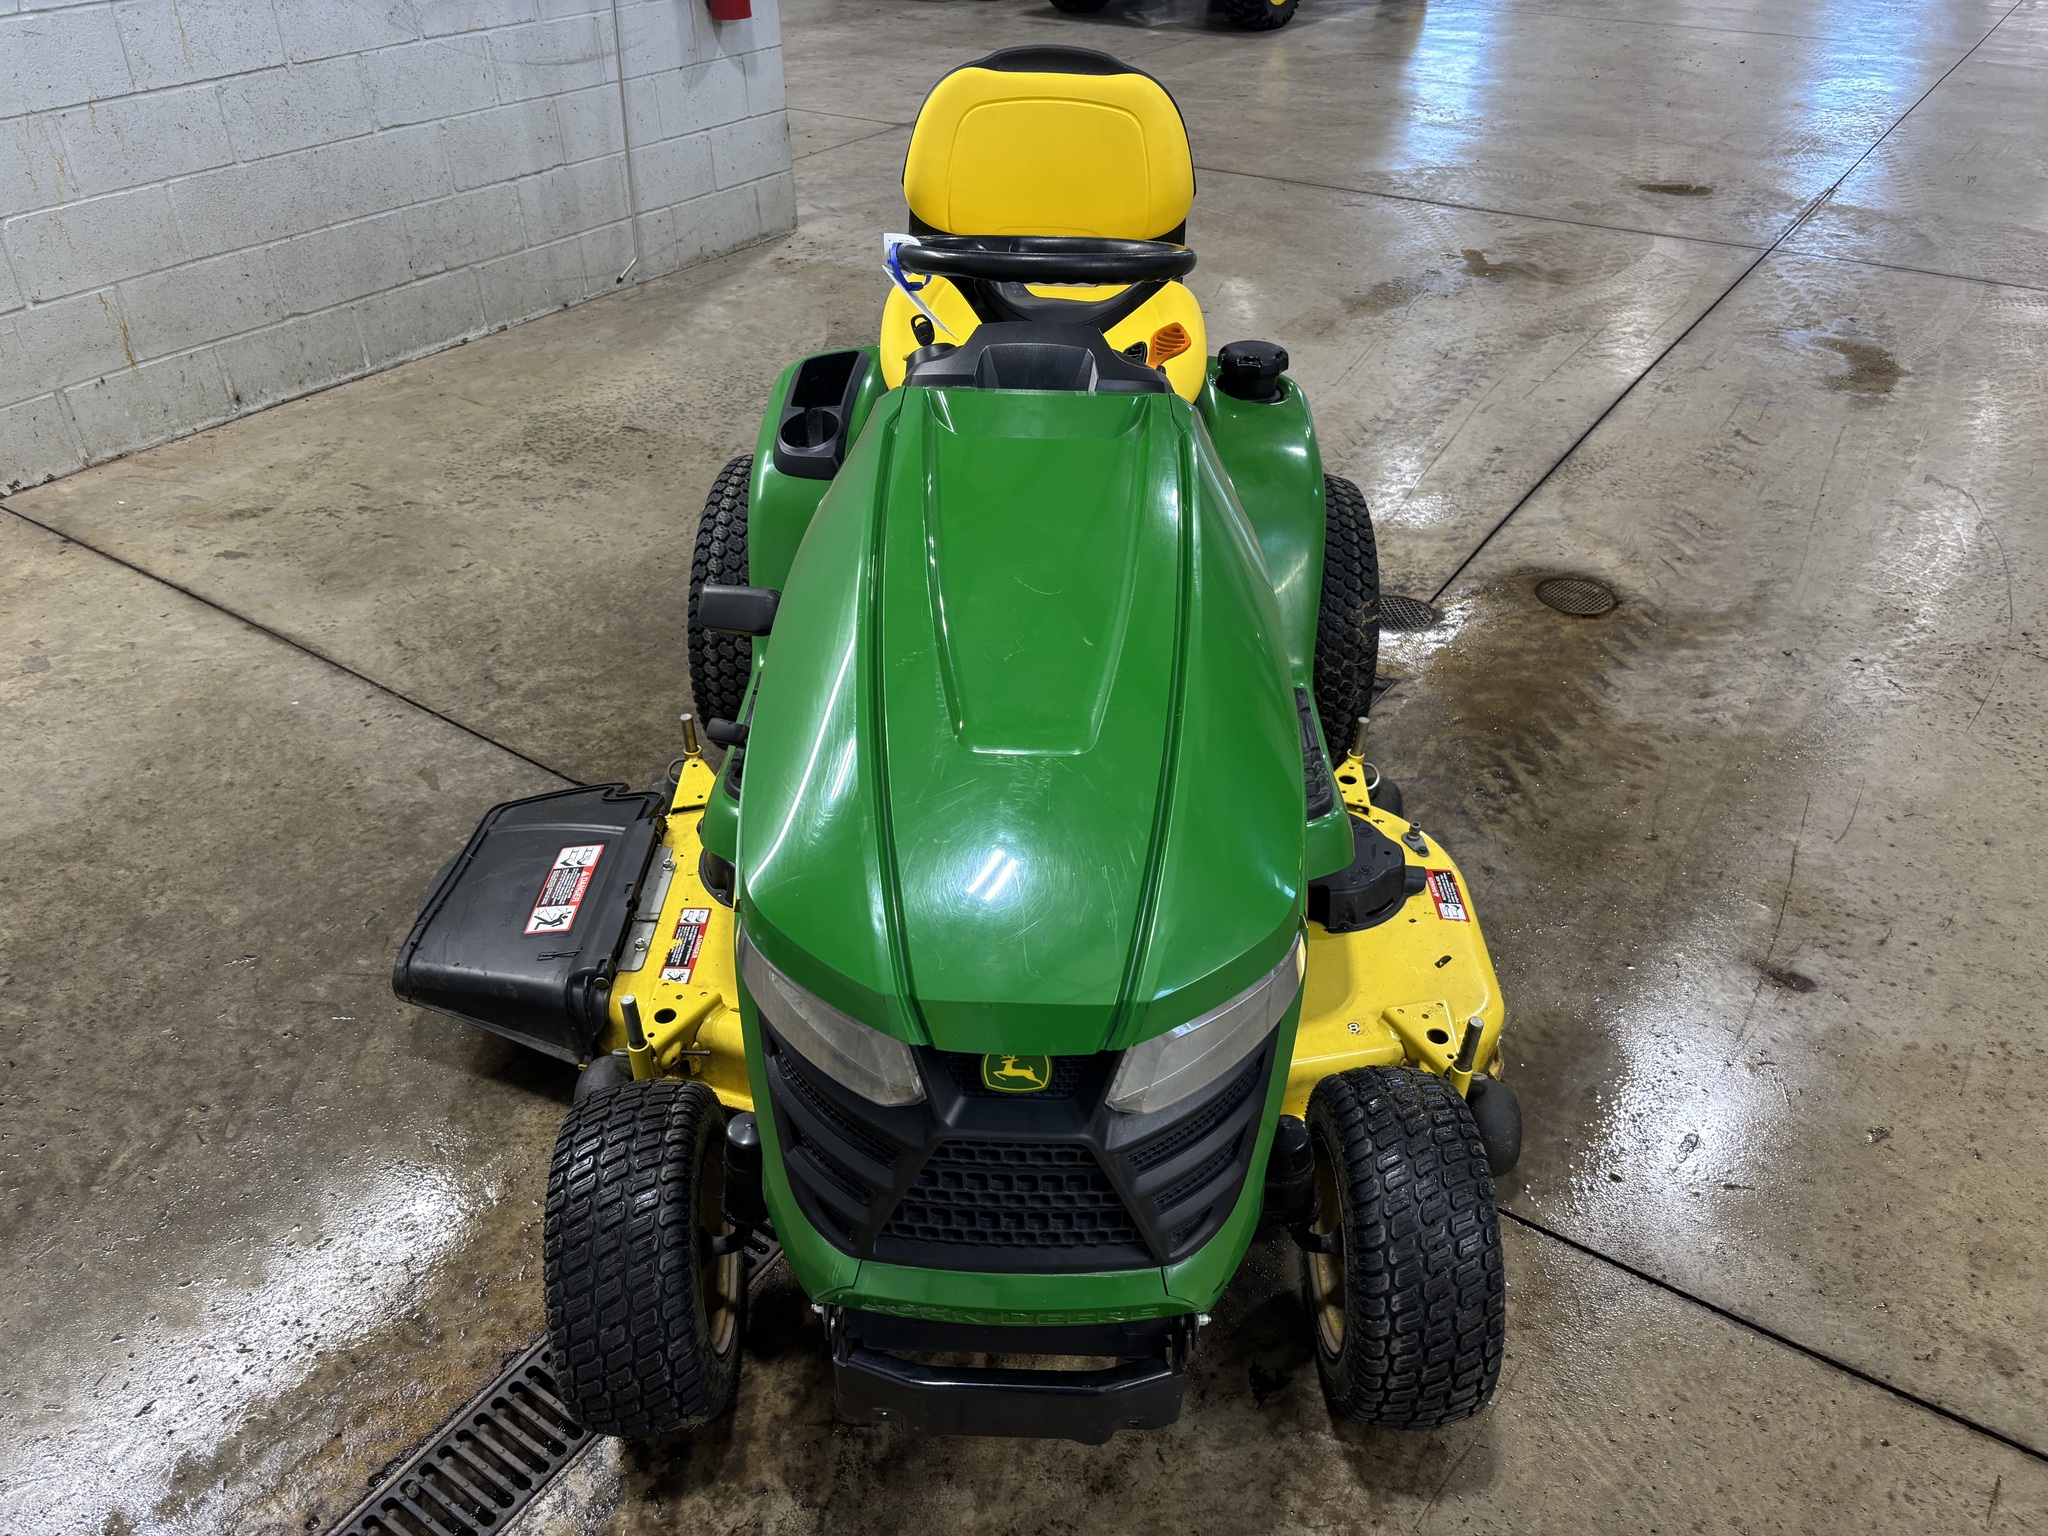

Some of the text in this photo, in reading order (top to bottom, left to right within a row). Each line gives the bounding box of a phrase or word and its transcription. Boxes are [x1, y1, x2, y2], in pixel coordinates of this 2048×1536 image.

[571, 876, 589, 902] DANGER
[691, 939, 703, 959] DANGER
[1000, 1307, 1160, 1325] DEERE
